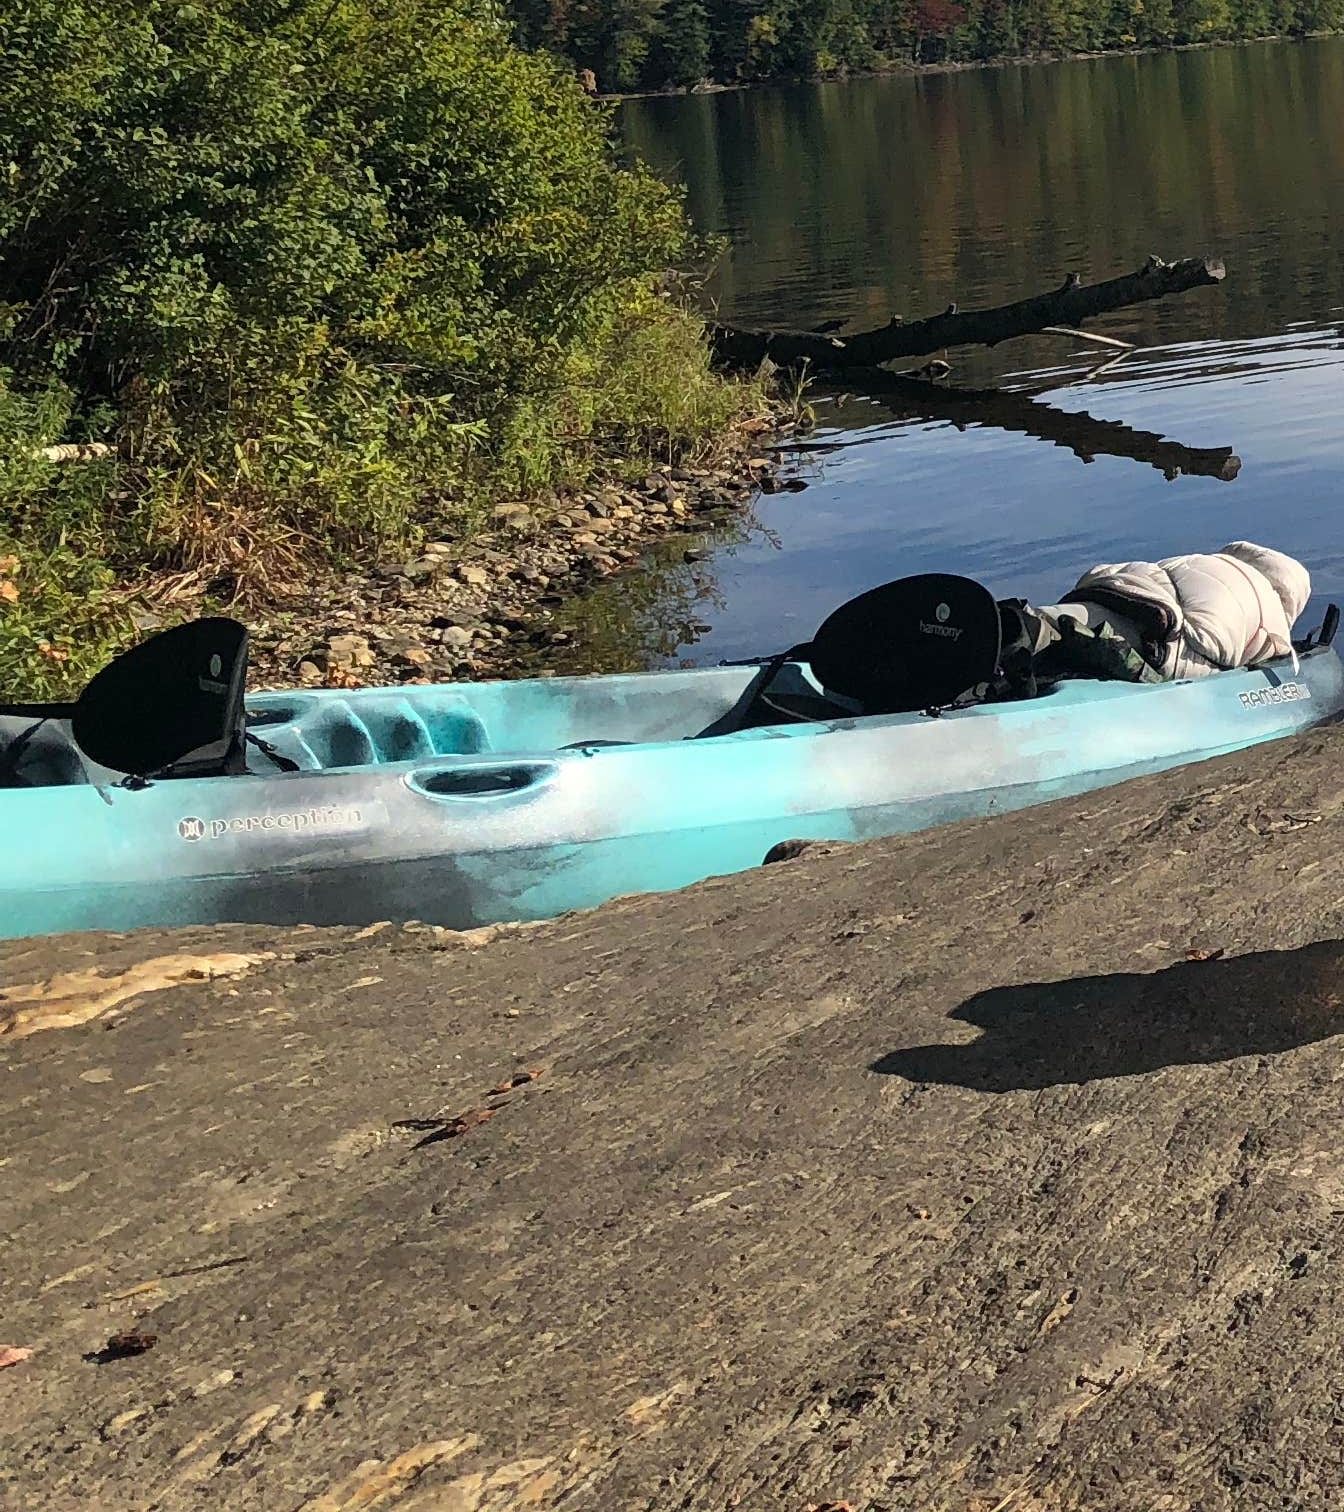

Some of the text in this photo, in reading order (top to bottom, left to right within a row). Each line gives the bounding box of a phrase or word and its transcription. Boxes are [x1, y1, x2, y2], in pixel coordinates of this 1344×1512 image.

[919, 620, 962, 641] harmony
[1238, 683, 1299, 708] RAMBLER
[210, 806, 362, 838] perception
